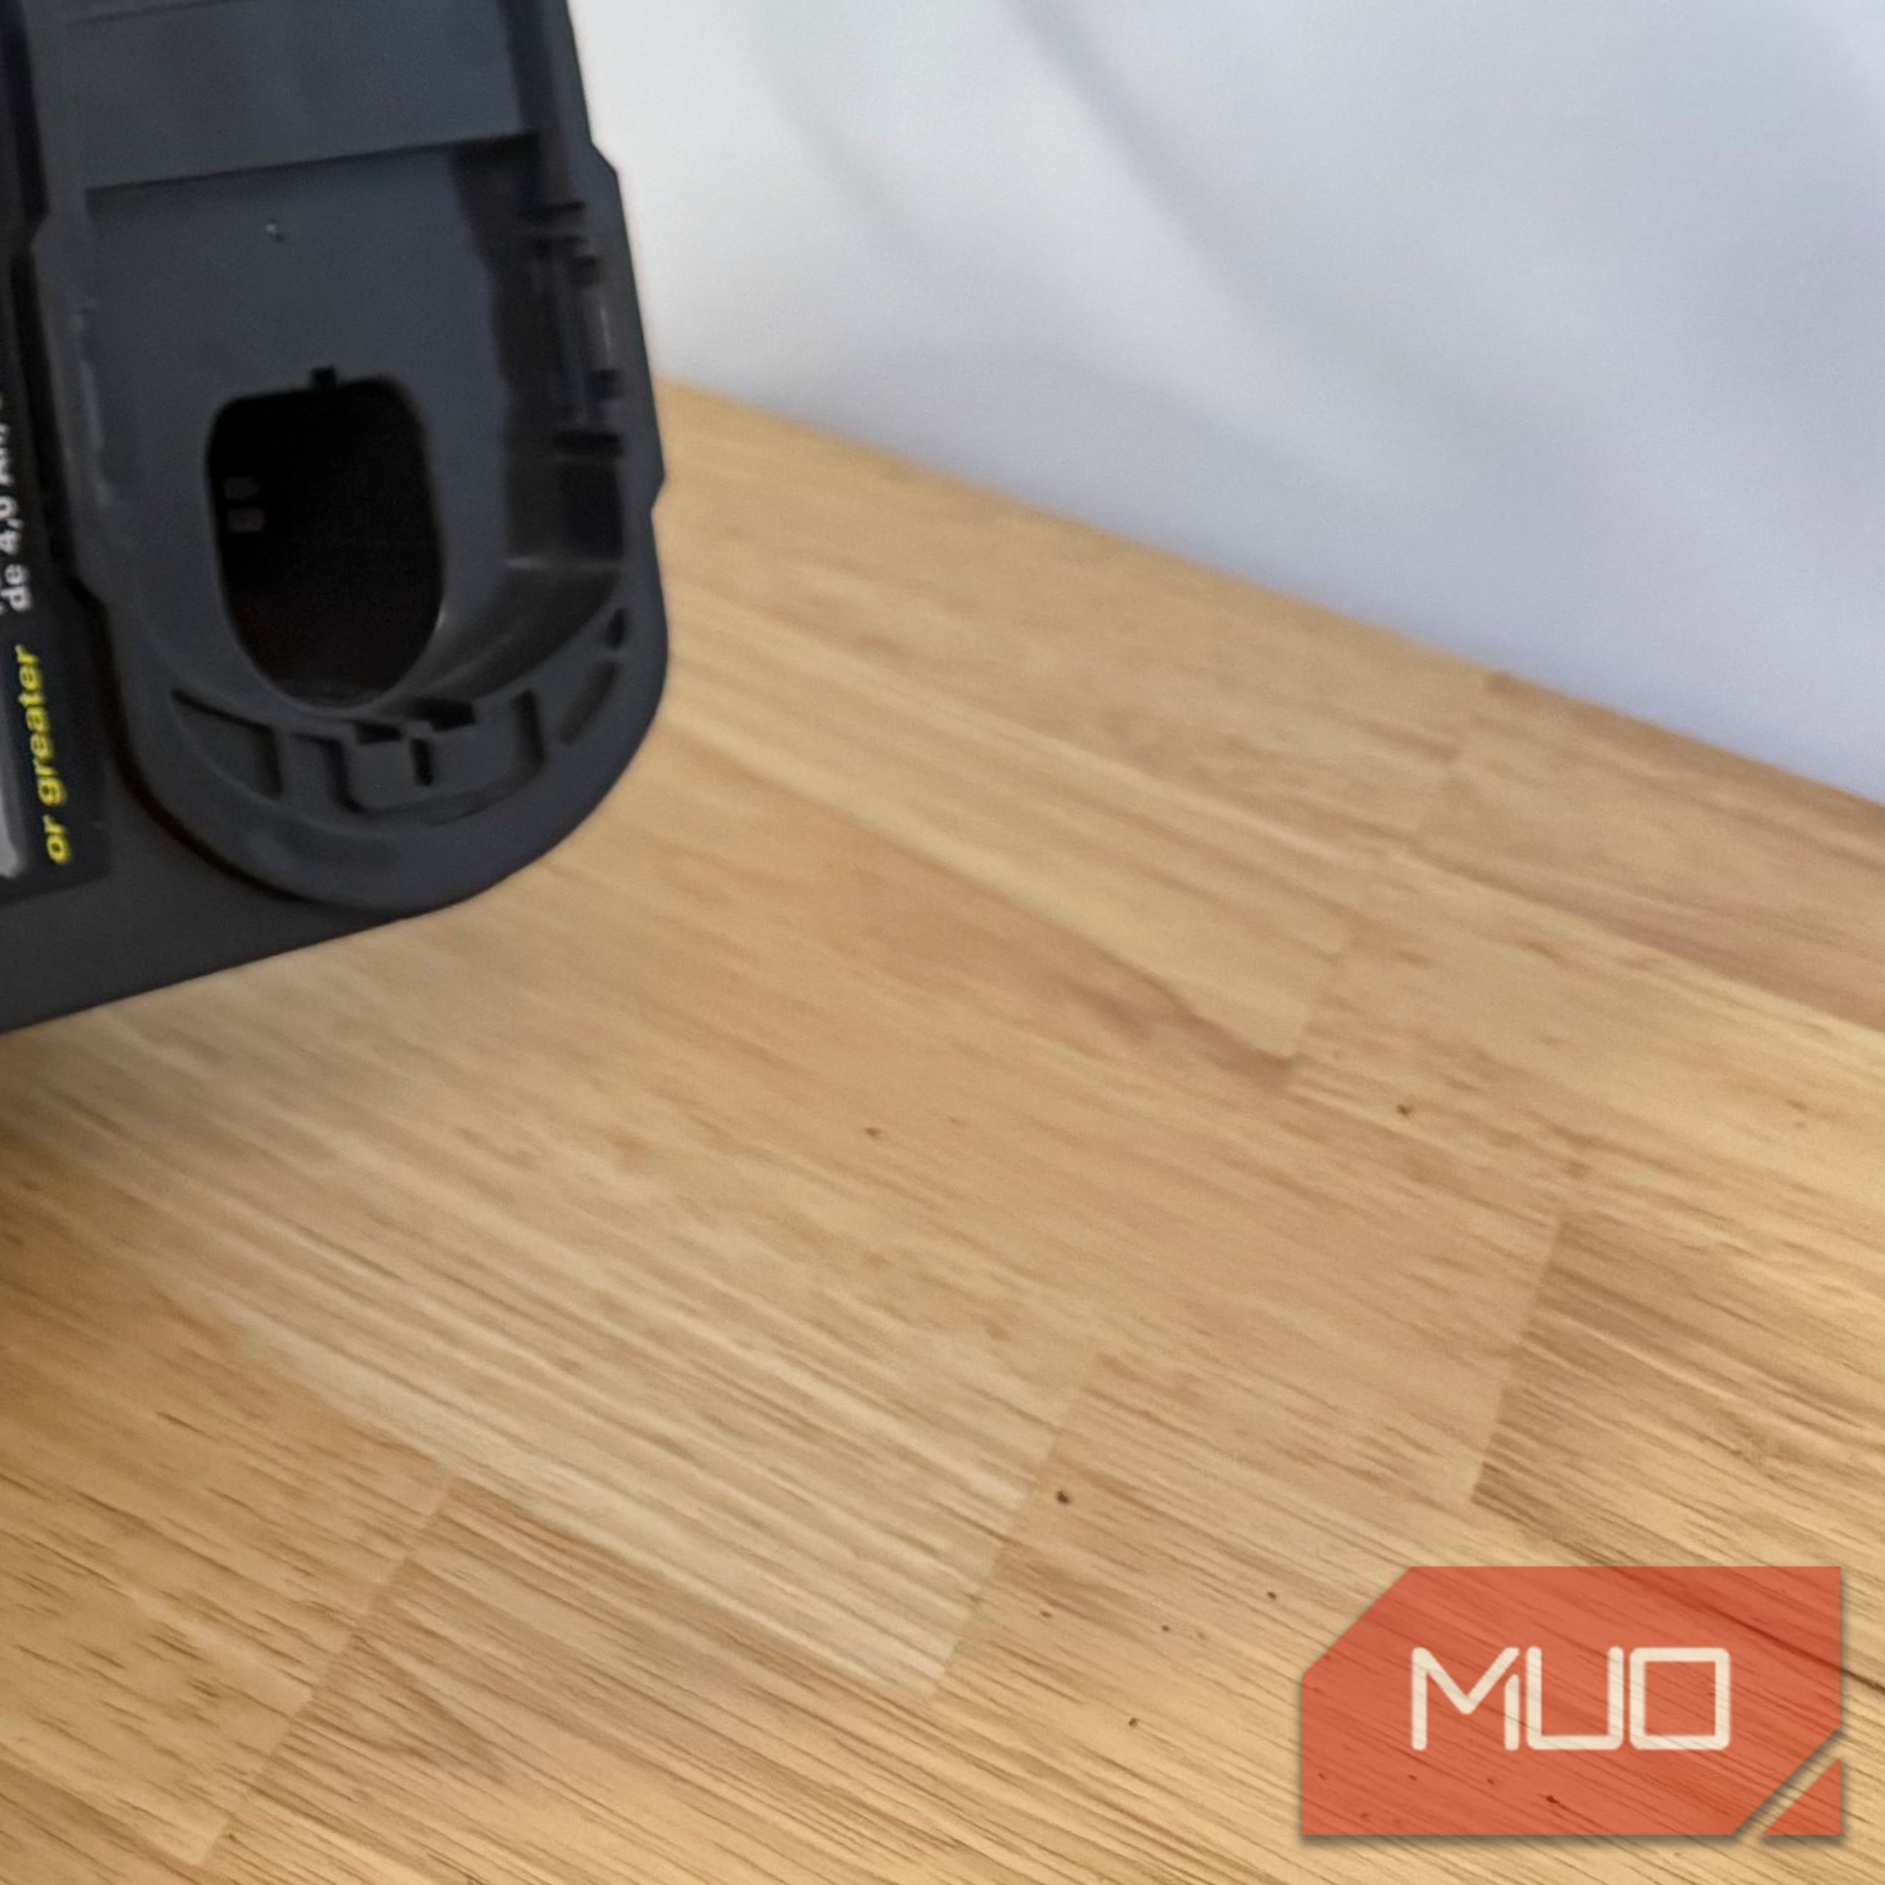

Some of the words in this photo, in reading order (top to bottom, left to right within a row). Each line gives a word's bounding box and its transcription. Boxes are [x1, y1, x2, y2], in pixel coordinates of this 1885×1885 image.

[0, 564, 30, 612] de
[14, 644, 67, 808] greater
[42, 814, 70, 865] or
